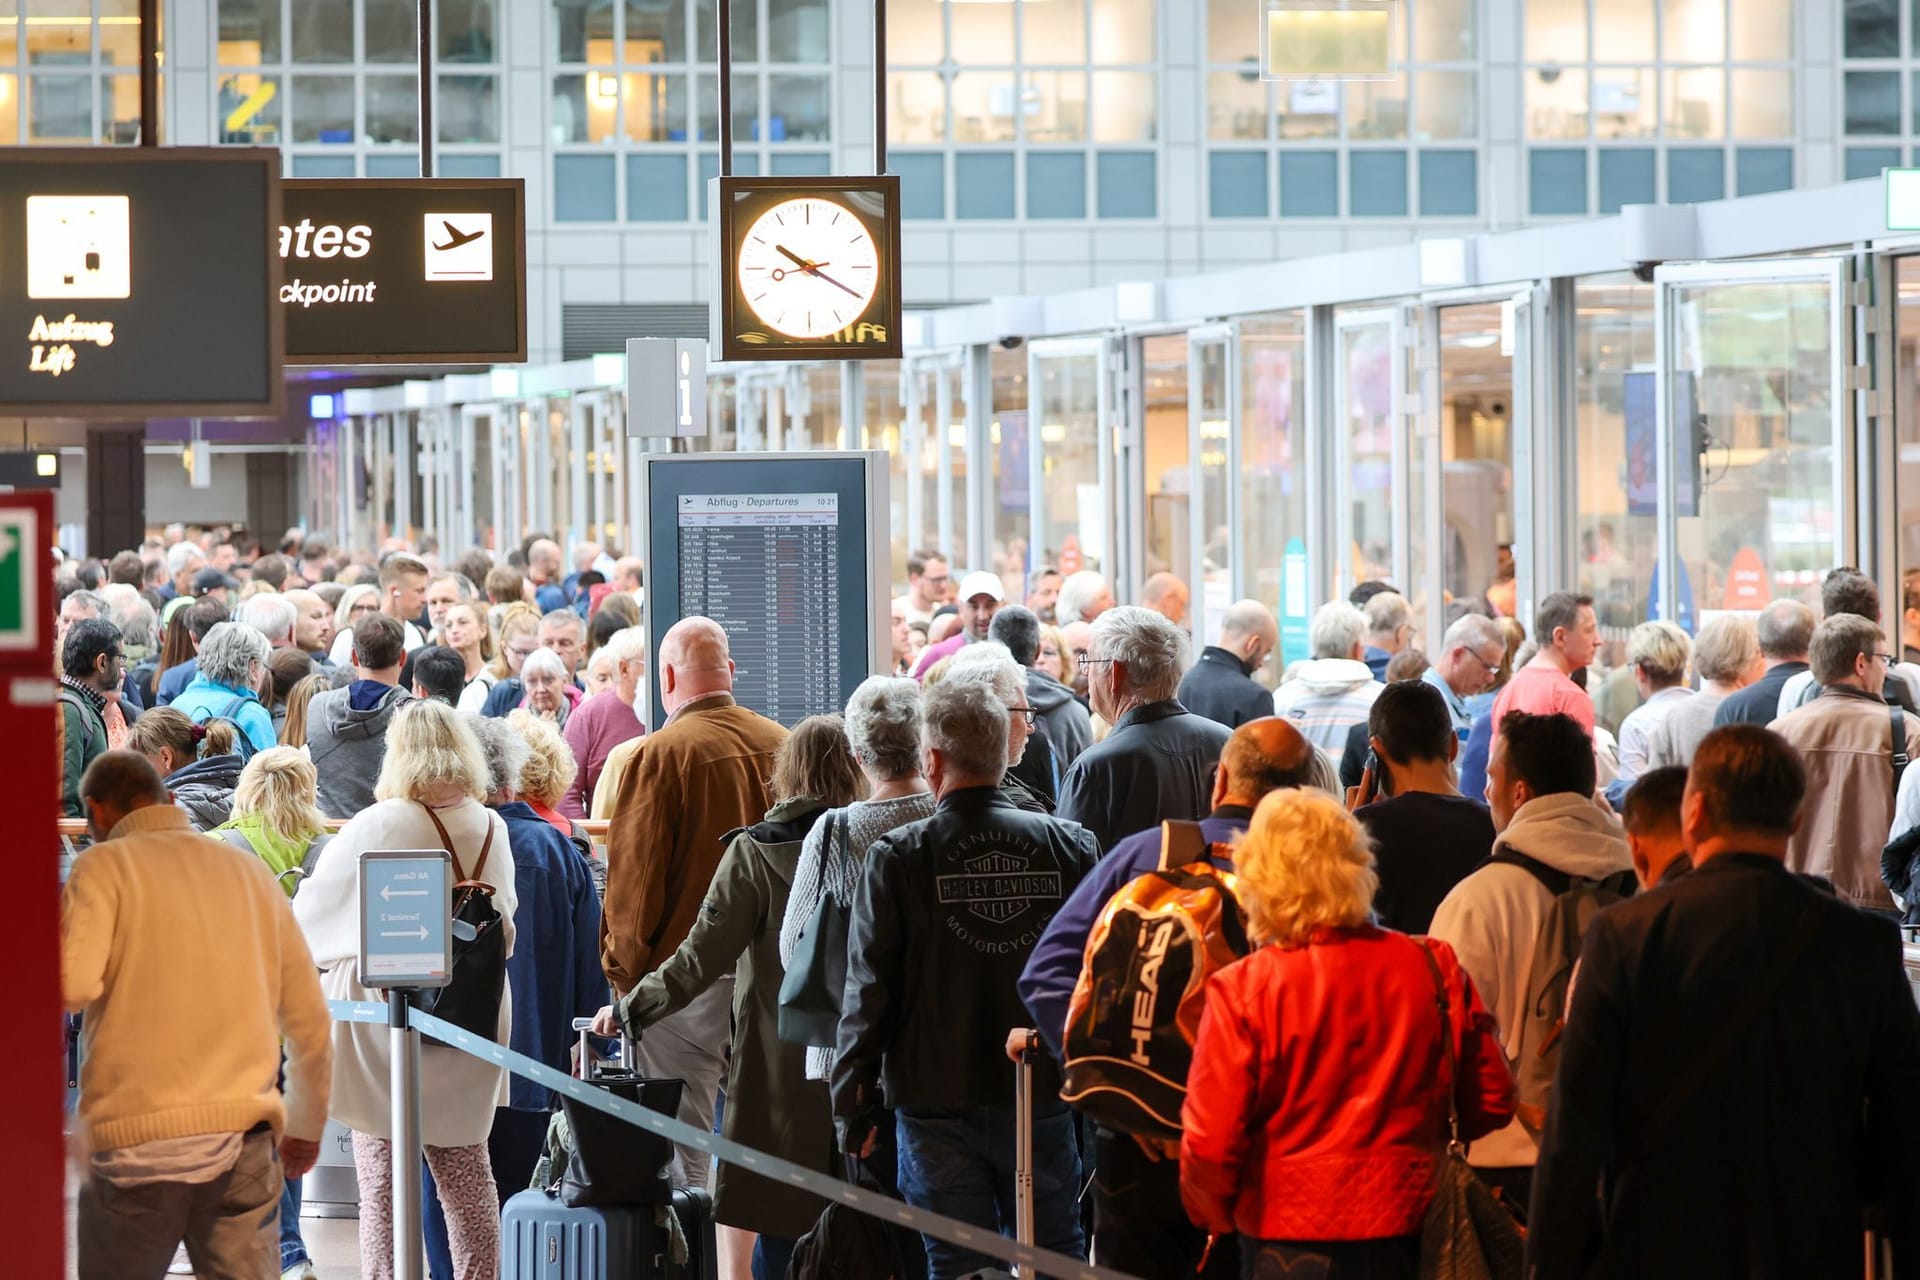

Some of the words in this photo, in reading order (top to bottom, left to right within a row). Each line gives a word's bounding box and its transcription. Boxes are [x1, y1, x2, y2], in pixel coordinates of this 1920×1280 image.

[279, 219, 372, 258] ates
[280, 279, 376, 308] ckpoint
[28, 313, 114, 347] Aufzug
[28, 343, 76, 376] Lift
[707, 497, 738, 507] Abflug
[746, 496, 799, 507] Departures
[972, 855, 1021, 873] MOTOR
[943, 880, 988, 898] HARLEY
[995, 878, 1057, 895] DAVIDSON
[974, 902, 1024, 918] CYCLES
[1131, 921, 1174, 1066] HEAD
